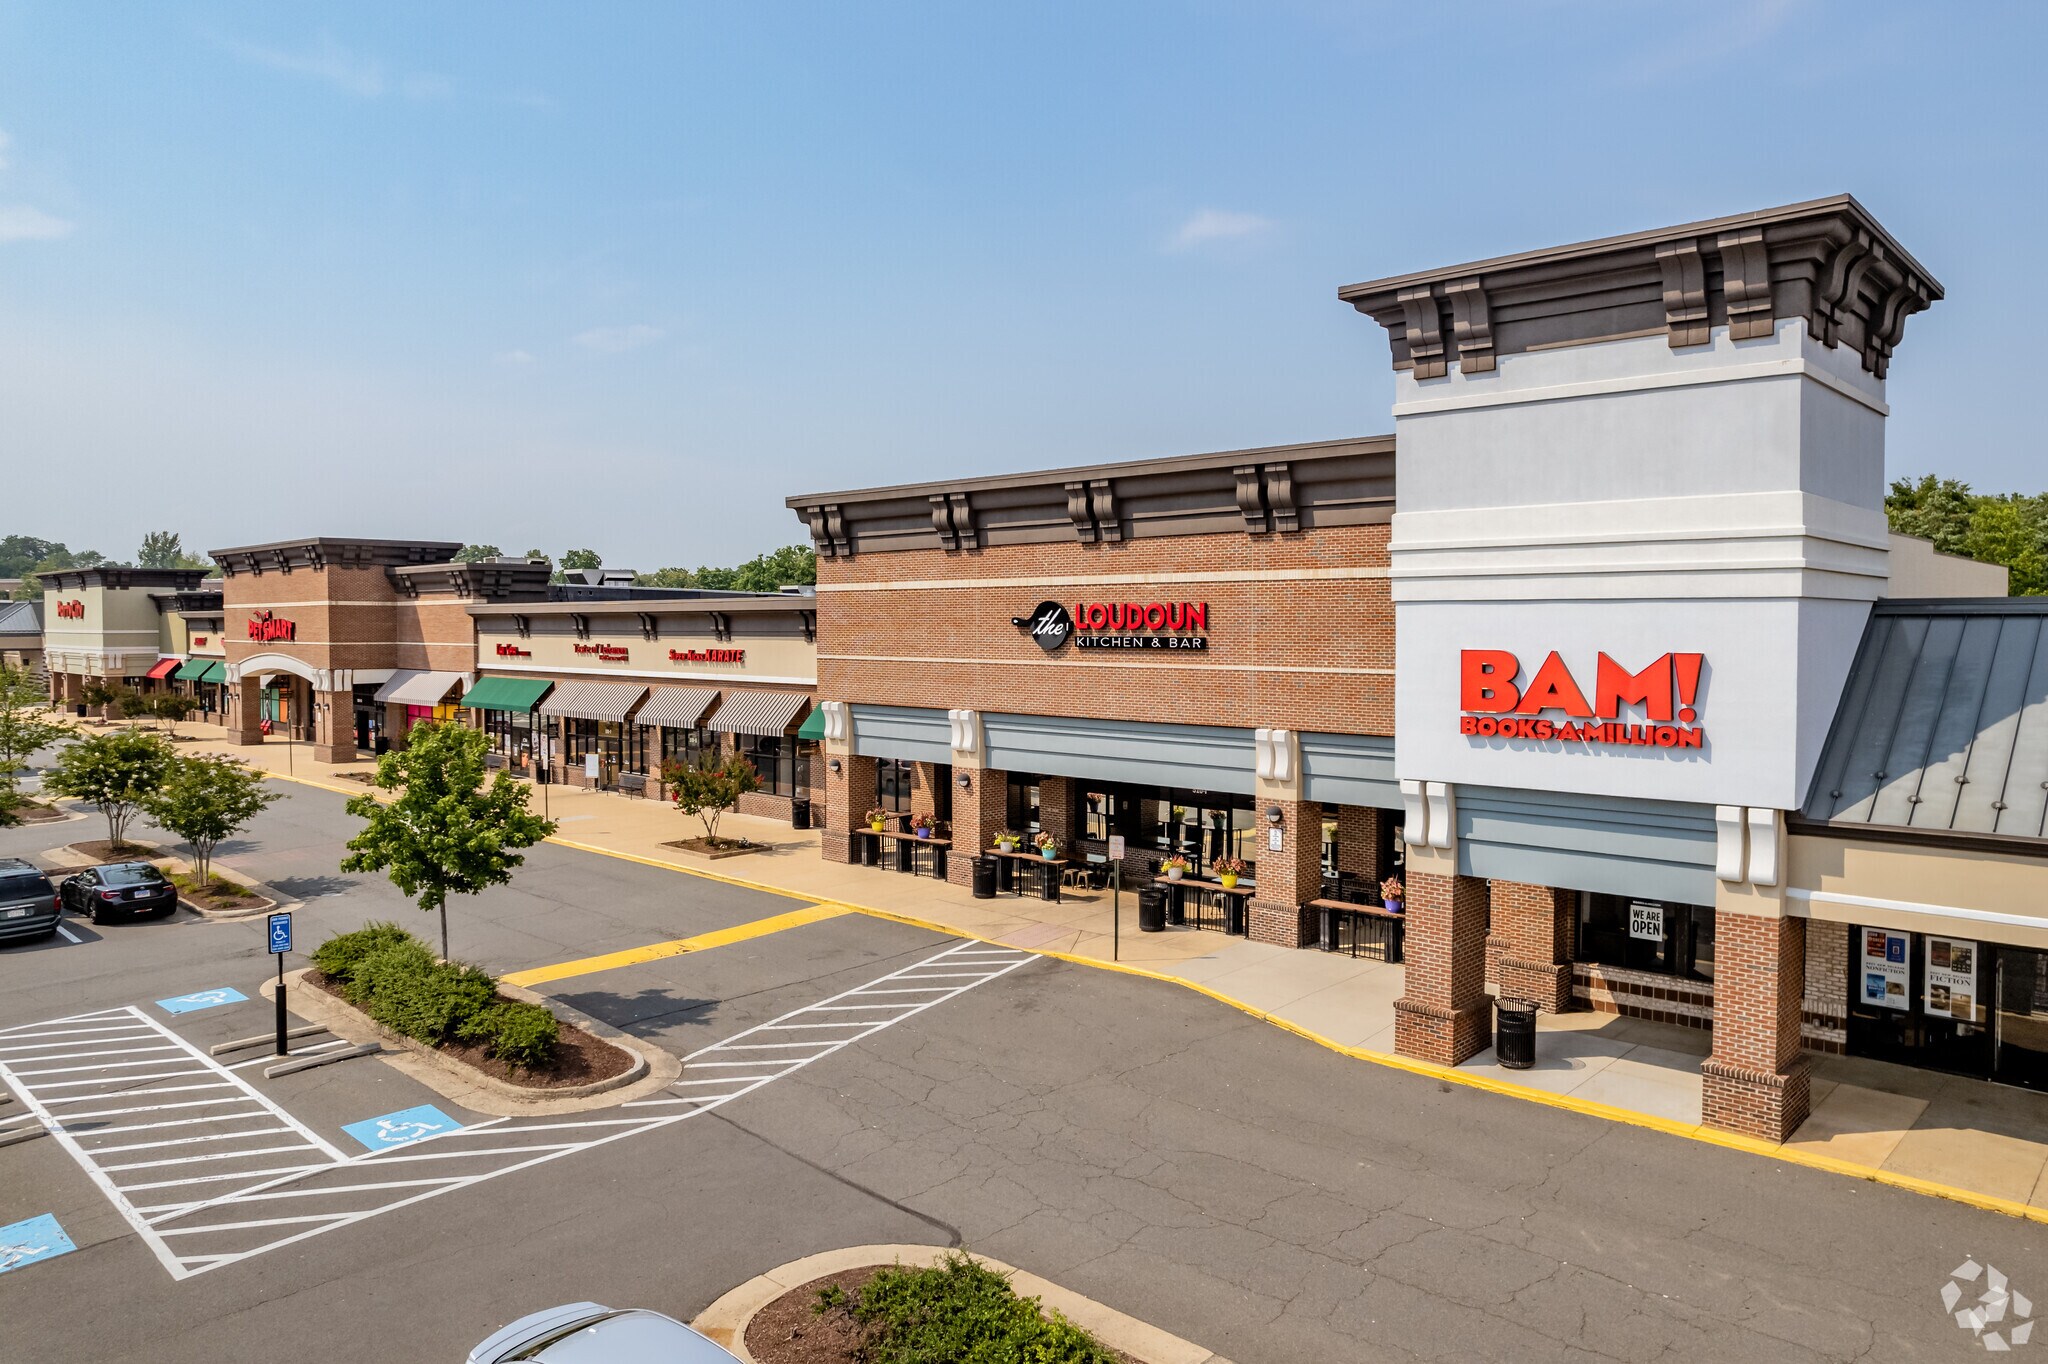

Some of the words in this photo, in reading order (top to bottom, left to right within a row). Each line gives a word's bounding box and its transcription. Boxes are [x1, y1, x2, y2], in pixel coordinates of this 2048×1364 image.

[1032, 608, 1063, 635] the
[1074, 602, 1208, 631] LOUDOUN
[1076, 636, 1143, 648] KITCHEN
[1151, 637, 1161, 648] &
[1169, 637, 1202, 649] BAR
[704, 648, 745, 663] KARATE
[1460, 648, 1705, 724] BAM!
[1633, 909, 1645, 919] WE
[1646, 911, 1660, 921] ARE
[1632, 920, 1660, 935] OPEN
[1865, 965, 1906, 975] NONFICTION
[1930, 974, 1972, 986] FICTION
